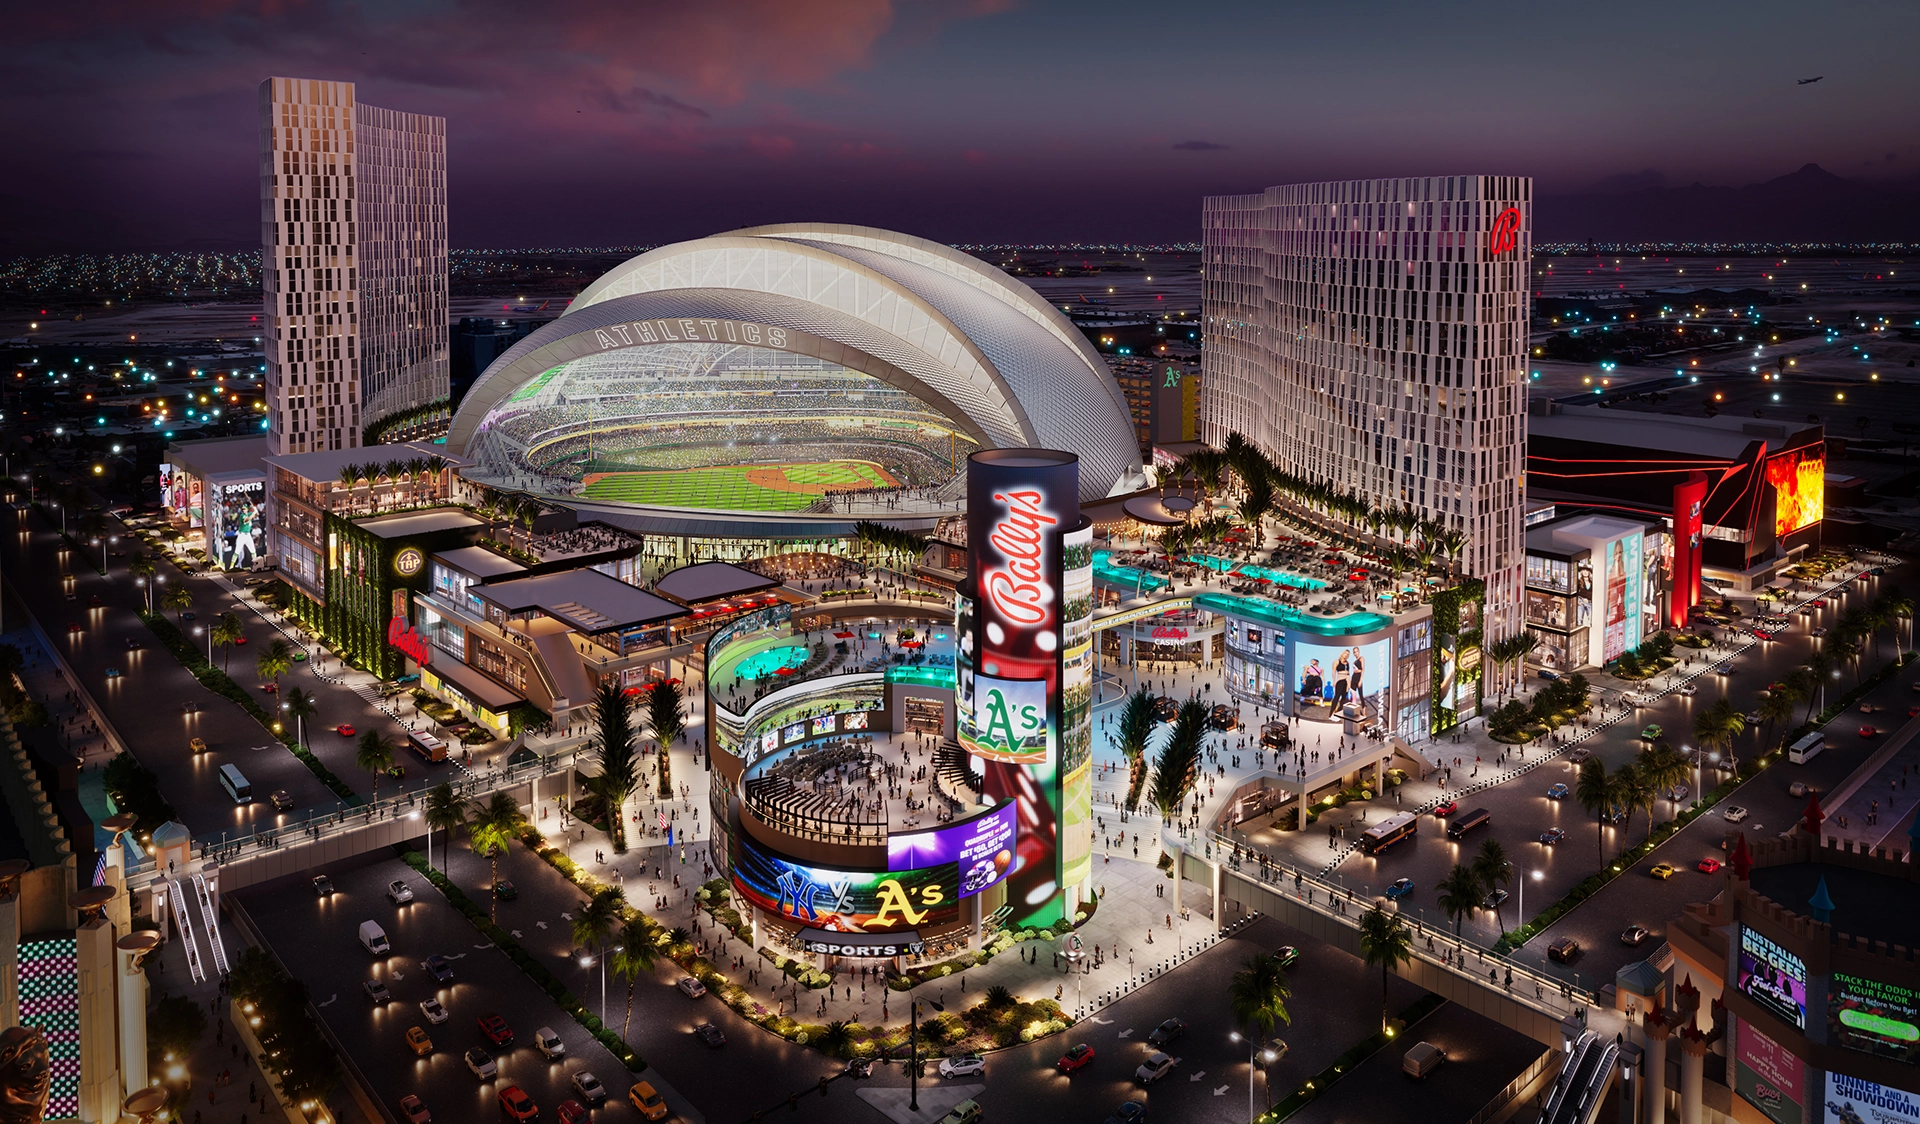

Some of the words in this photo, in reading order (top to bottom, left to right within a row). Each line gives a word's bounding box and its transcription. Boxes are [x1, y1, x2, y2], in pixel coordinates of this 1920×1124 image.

[1491, 207, 1521, 255] B
[595, 320, 786, 348] ATHLETICS
[1163, 366, 1180, 388] A's
[225, 482, 262, 494] SPORTS
[399, 559, 420, 570] TAP
[990, 491, 1057, 624] Bally's
[1629, 536, 1638, 649] WESTERN
[388, 615, 429, 668] Bally's
[1151, 626, 1188, 640] Bally's
[977, 688, 1038, 752] A's
[960, 848, 973, 859] BET
[862, 879, 944, 928] A's
[816, 944, 896, 955] SPORTS
[1742, 934, 1767, 962] BEE
[1767, 952, 1802, 982] GEES
[1834, 973, 1863, 986] STACK
[1865, 979, 1883, 990] THE
[1885, 984, 1913, 997] ODDS
[1848, 984, 1874, 997] YOUR
[1877, 991, 1911, 1006] FAVOR.
[1840, 992, 1864, 1003] Budget
[1865, 998, 1888, 1008] Before
[1889, 1003, 1902, 1011] You
[1844, 1012, 1917, 1038] GameSense
[1746, 1051, 1770, 1070] HAPPY
[1771, 1069, 1793, 1088] HOUR
[1832, 1071, 1881, 1095] DINNER
[1884, 1089, 1901, 1101] AND
[1904, 1095, 1910, 1103] A
[1835, 1084, 1919, 1118] SHOWDOWN
